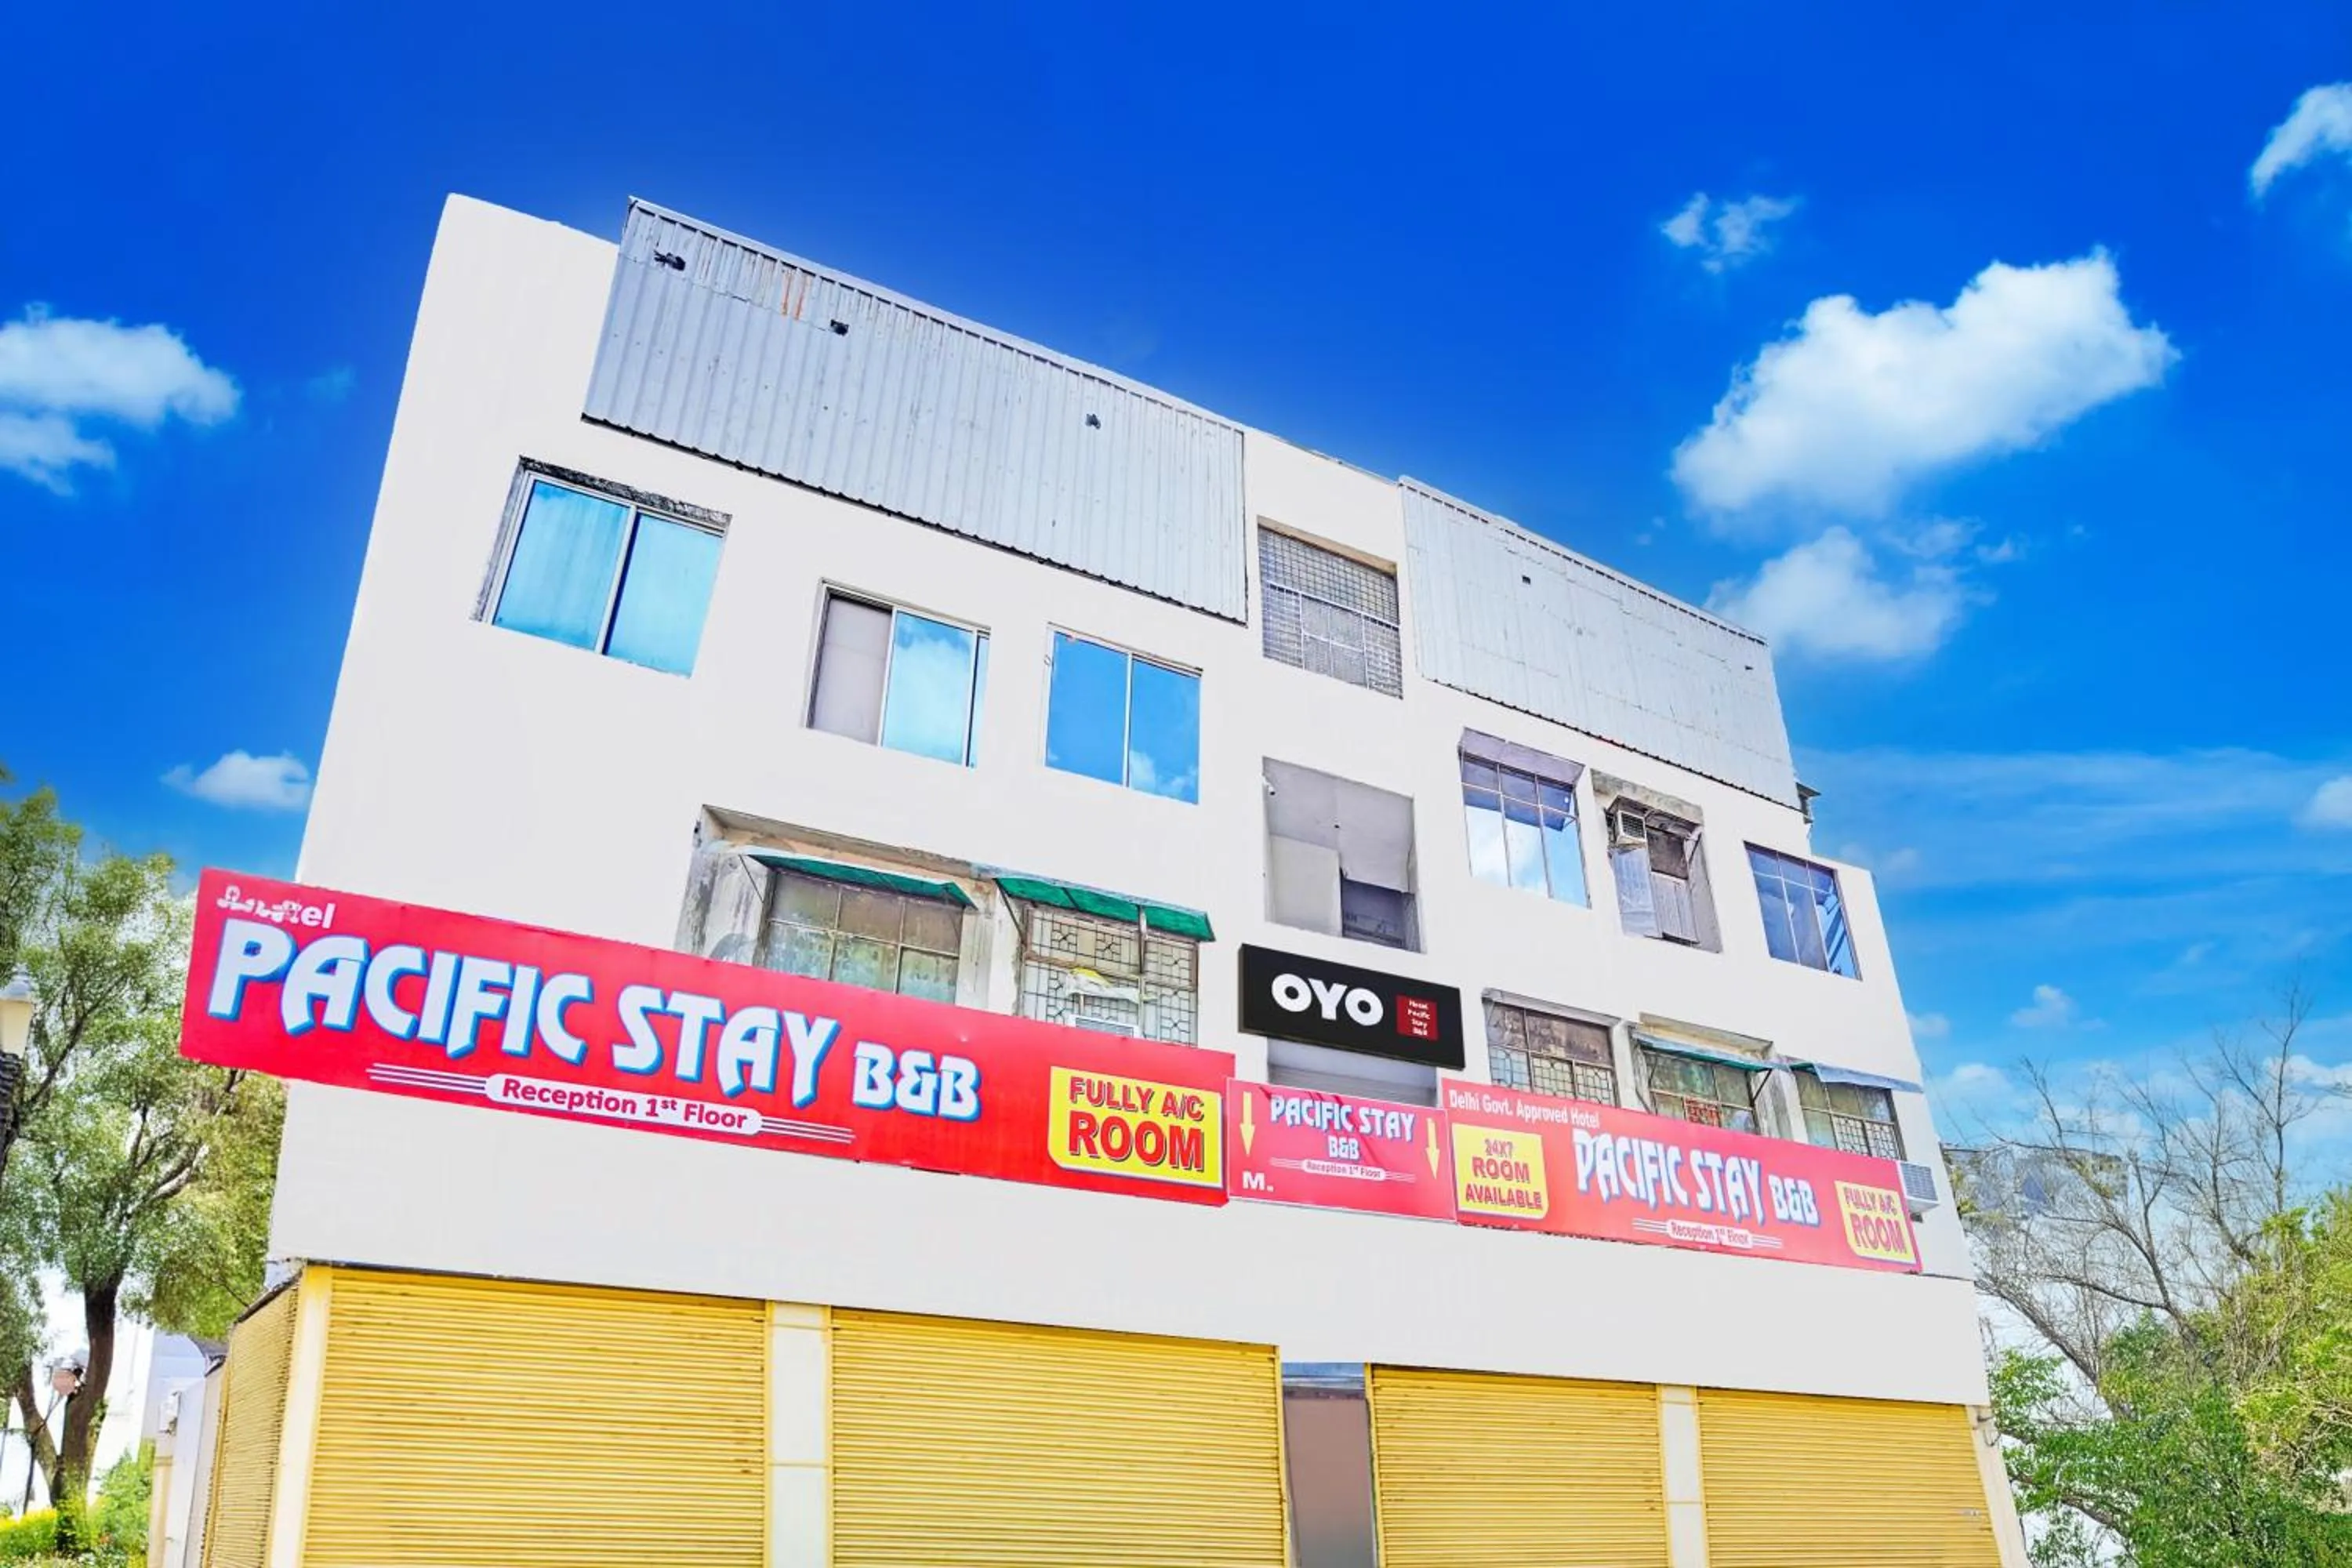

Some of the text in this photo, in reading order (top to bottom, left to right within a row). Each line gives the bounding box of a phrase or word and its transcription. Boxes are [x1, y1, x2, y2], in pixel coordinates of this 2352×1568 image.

[1271, 973, 1384, 1026] OYO
[208, 918, 982, 1122] PACIFIC STAY B&B
[502, 1078, 747, 1129] Reception 1st Floor
[1069, 1076, 1156, 1114] FULLY
[1449, 1090, 1600, 1129] Delhi Govt. Approved Hotel
[1270, 1094, 1415, 1142] PACIFIC STAY
[1069, 1110, 1205, 1173] ROOM
[1328, 1134, 1360, 1160] B&B
[1242, 1171, 1274, 1192] M.
[1472, 1156, 1530, 1185] ROOM
[1572, 1128, 1820, 1227] PACIFIC STAY B&B
[1465, 1182, 1542, 1210] AVAILABLE
[1843, 1186, 1876, 1212] FULLY
[1850, 1213, 1907, 1255] ROOM
